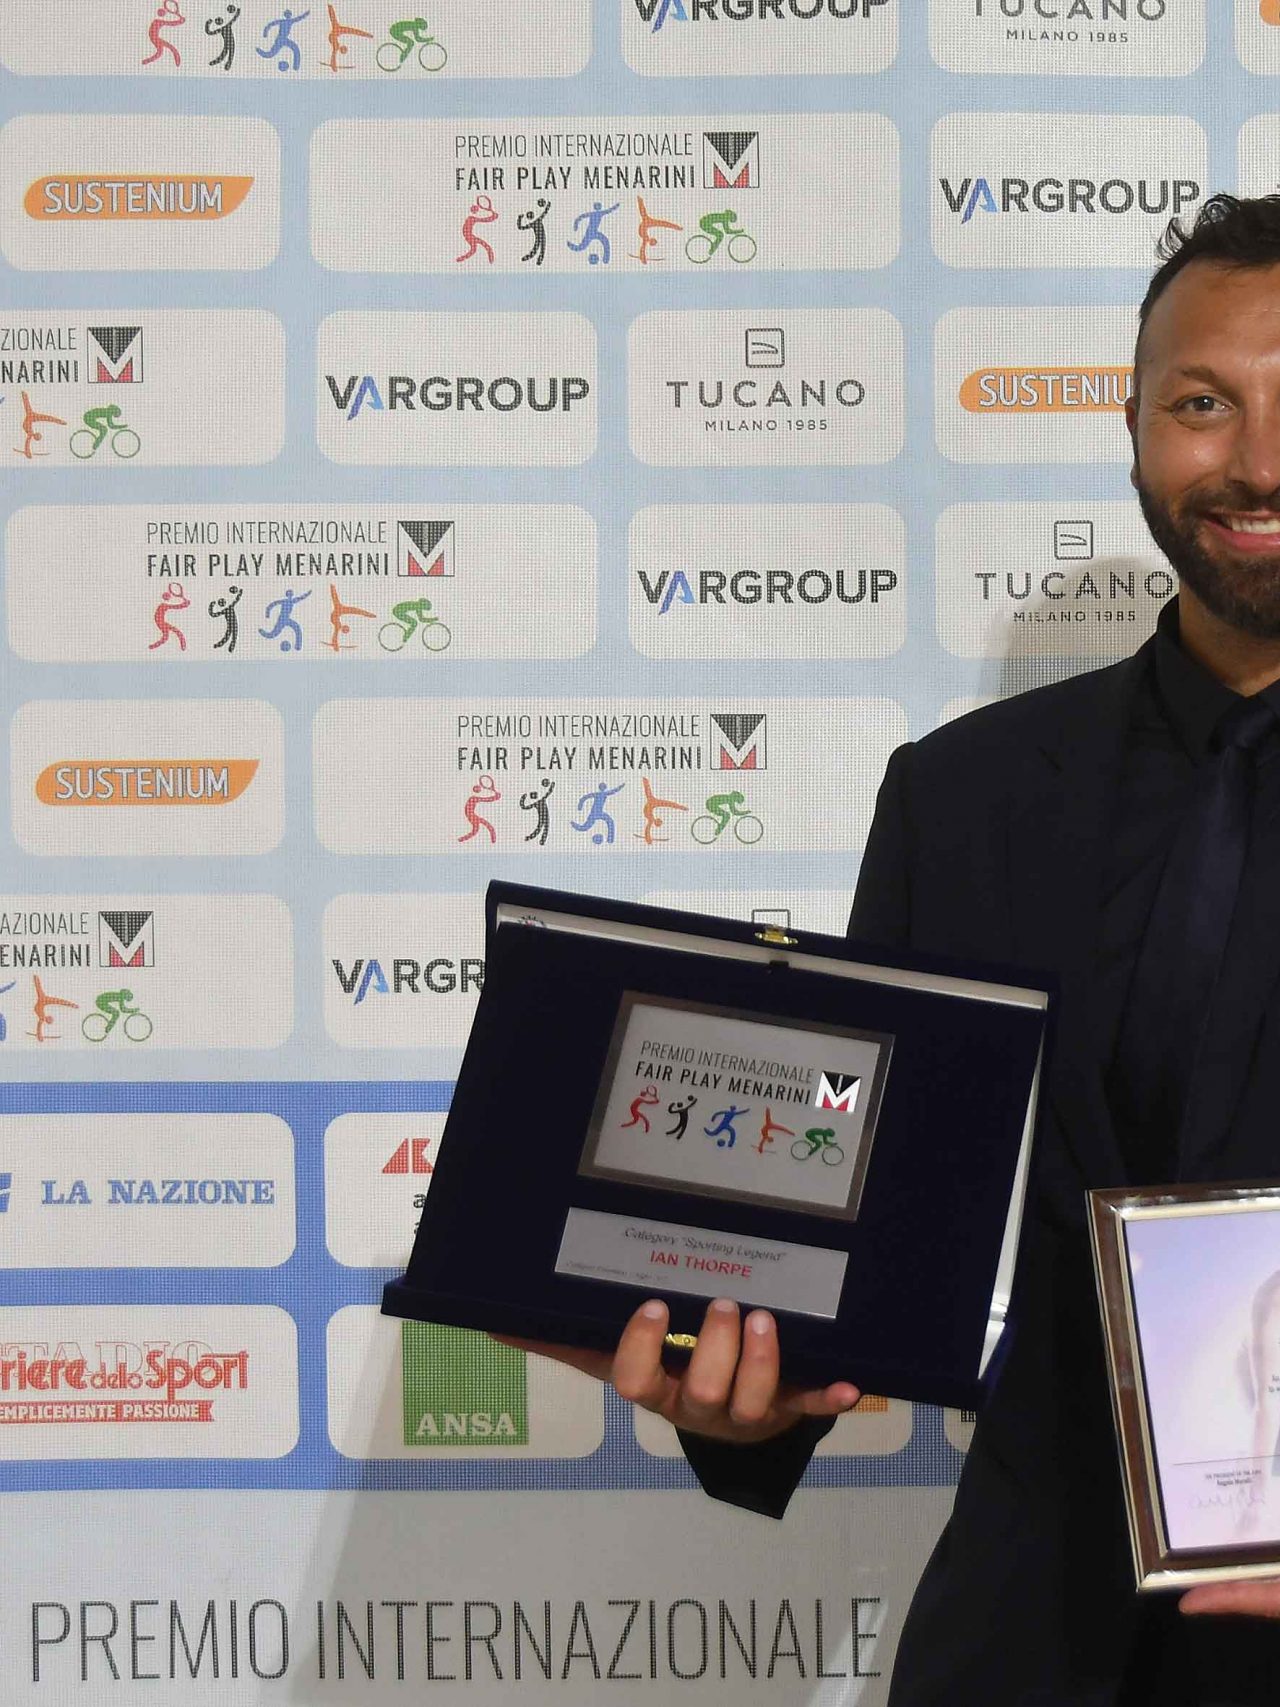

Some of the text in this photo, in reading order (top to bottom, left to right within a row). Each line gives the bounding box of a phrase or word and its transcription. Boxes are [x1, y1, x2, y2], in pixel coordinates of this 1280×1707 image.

[1006, 29, 1129, 43] MILANO 1985
[455, 133, 692, 158] PREMIO INTERNAZIONALE
[456, 165, 695, 190] FAIR PLAY MENARINI
[43, 181, 223, 214] SUSTENIUM
[940, 178, 1200, 224] VARGROUP
[326, 376, 589, 420] VARGROUP
[666, 380, 865, 408] TUCANO
[705, 419, 827, 431] MILANO 1985
[147, 521, 386, 545] PREMIO INTERNAZIONALE
[147, 553, 389, 577] FAIR PLAY MENARINI
[638, 569, 897, 612] VARGROUP
[976, 571, 1173, 600] TUCANO
[1014, 611, 1135, 623] MILANO 1985
[458, 715, 700, 738] PREMIO INTERNAZIONALE
[458, 746, 701, 770] FAIR PLAY MENARINI
[55, 768, 229, 800] SUSTENIUM
[641, 1040, 814, 1084] PREMIO INTERNAZIONALE
[636, 1061, 811, 1105] FAIR PLAY MENARINI
[41, 1180, 92, 1205] LA
[107, 1179, 275, 1205] NAZIONE
[624, 1227, 678, 1245] Category
[650, 1250, 679, 1267] IAN
[685, 1255, 753, 1278] THORPE
[146, 1350, 248, 1400] Sport
[123, 1403, 200, 1422] PASSIONE
[416, 1412, 518, 1438] ANSA
[31, 1597, 882, 1682] PREMIO INTERNAZIONALE
